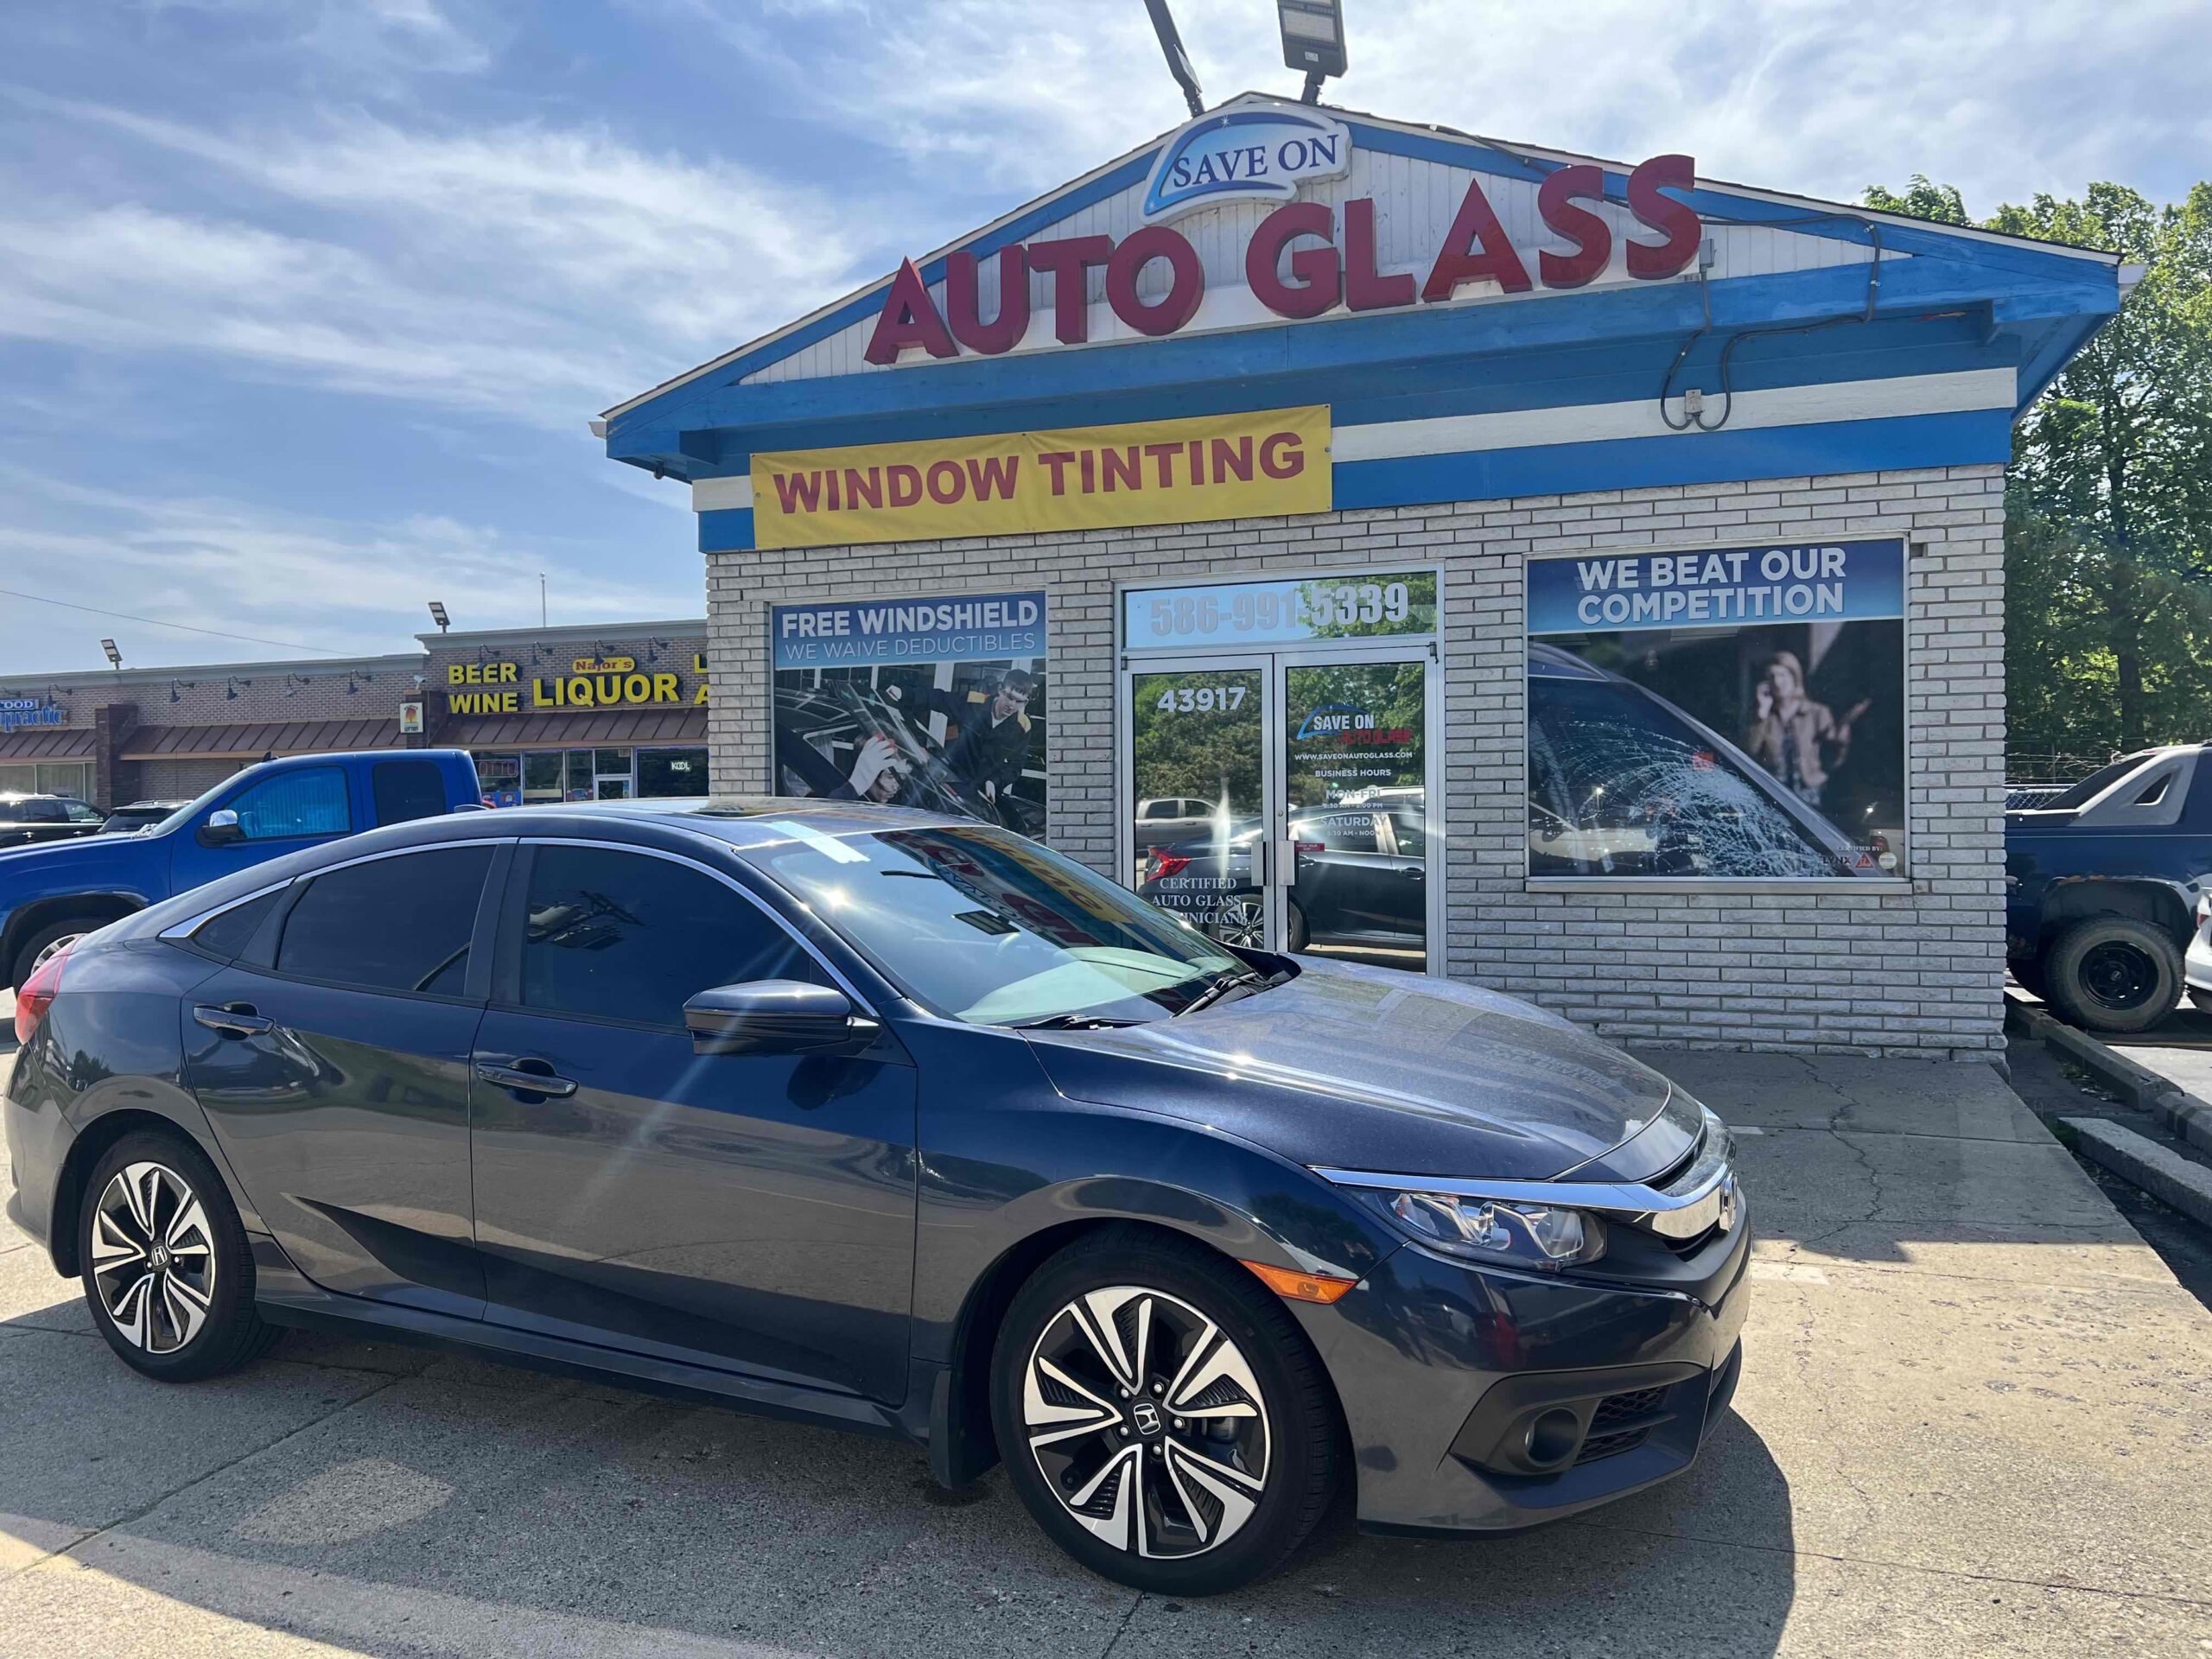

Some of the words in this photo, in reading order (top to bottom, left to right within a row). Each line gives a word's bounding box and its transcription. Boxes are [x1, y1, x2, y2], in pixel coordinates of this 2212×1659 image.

[1173, 145, 1268, 188] SAVE
[1278, 134, 1338, 171] ON
[865, 226, 1204, 365] AUTO
[1245, 154, 1700, 319] GLASS
[772, 455, 1019, 515] WINDOW
[1038, 432, 1305, 496] TINTING
[1577, 558, 1639, 591] WE
[1650, 552, 1749, 588] BEAT
[1760, 547, 1847, 582] OUR
[1151, 582, 1408, 636] 586-991-5339
[1578, 582, 1844, 625] COMPETITION
[782, 610, 851, 639] FREE
[857, 600, 1038, 635] WINDSHIELD
[785, 643, 817, 661] WE
[823, 639, 888, 658] WAIVE
[895, 632, 1035, 656] DEDUCTIBLES
[448, 663, 518, 684] BEER
[448, 692, 518, 714] WINE
[532, 673, 680, 708] LIQUOR
[1158, 686, 1246, 713] 43917
[1313, 715, 1350, 731] SAVE
[1355, 714, 1375, 729] ON
[1294, 751, 1413, 760] WWW.SAVEONAUTOGLASS.COM
[1315, 769, 1357, 778] BUSINESS
[1325, 789, 1381, 799] MON-FRI
[1321, 817, 1388, 827] SATURDAY
[1160, 878, 1236, 889] CERTIFIED
[1152, 894, 1192, 906] AUTO
[1195, 894, 1243, 906] GLASS
